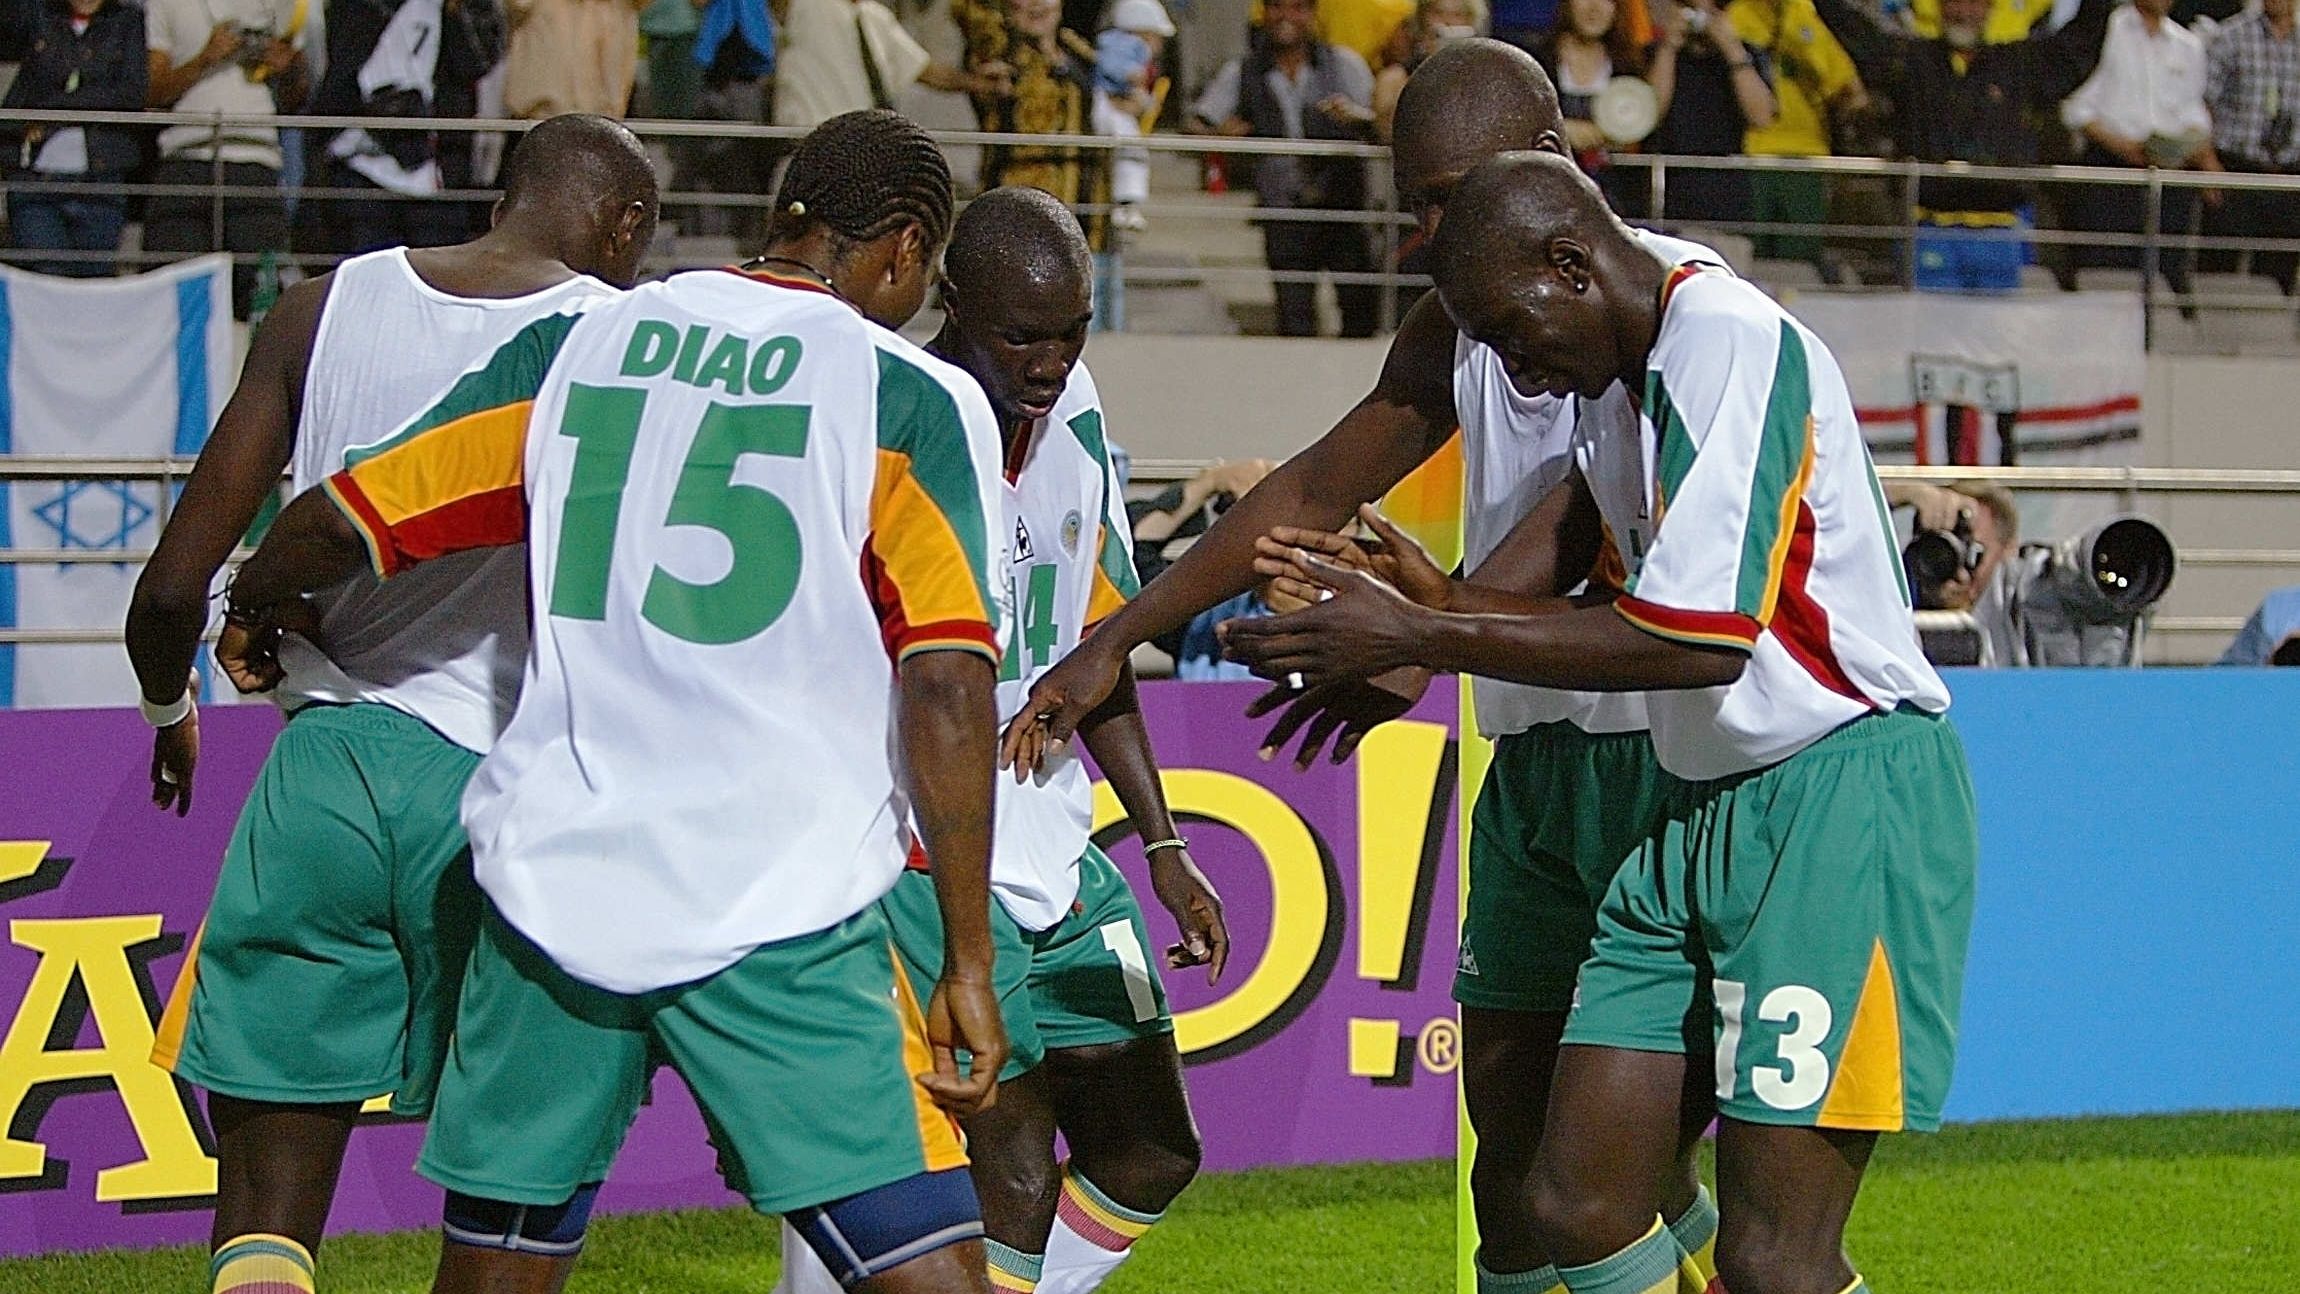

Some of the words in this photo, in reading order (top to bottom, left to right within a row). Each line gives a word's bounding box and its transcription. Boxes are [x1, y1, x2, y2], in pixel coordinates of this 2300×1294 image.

[619, 319, 803, 396] DIAO
[549, 381, 813, 646] 15
[1711, 977, 1833, 1111] 13
